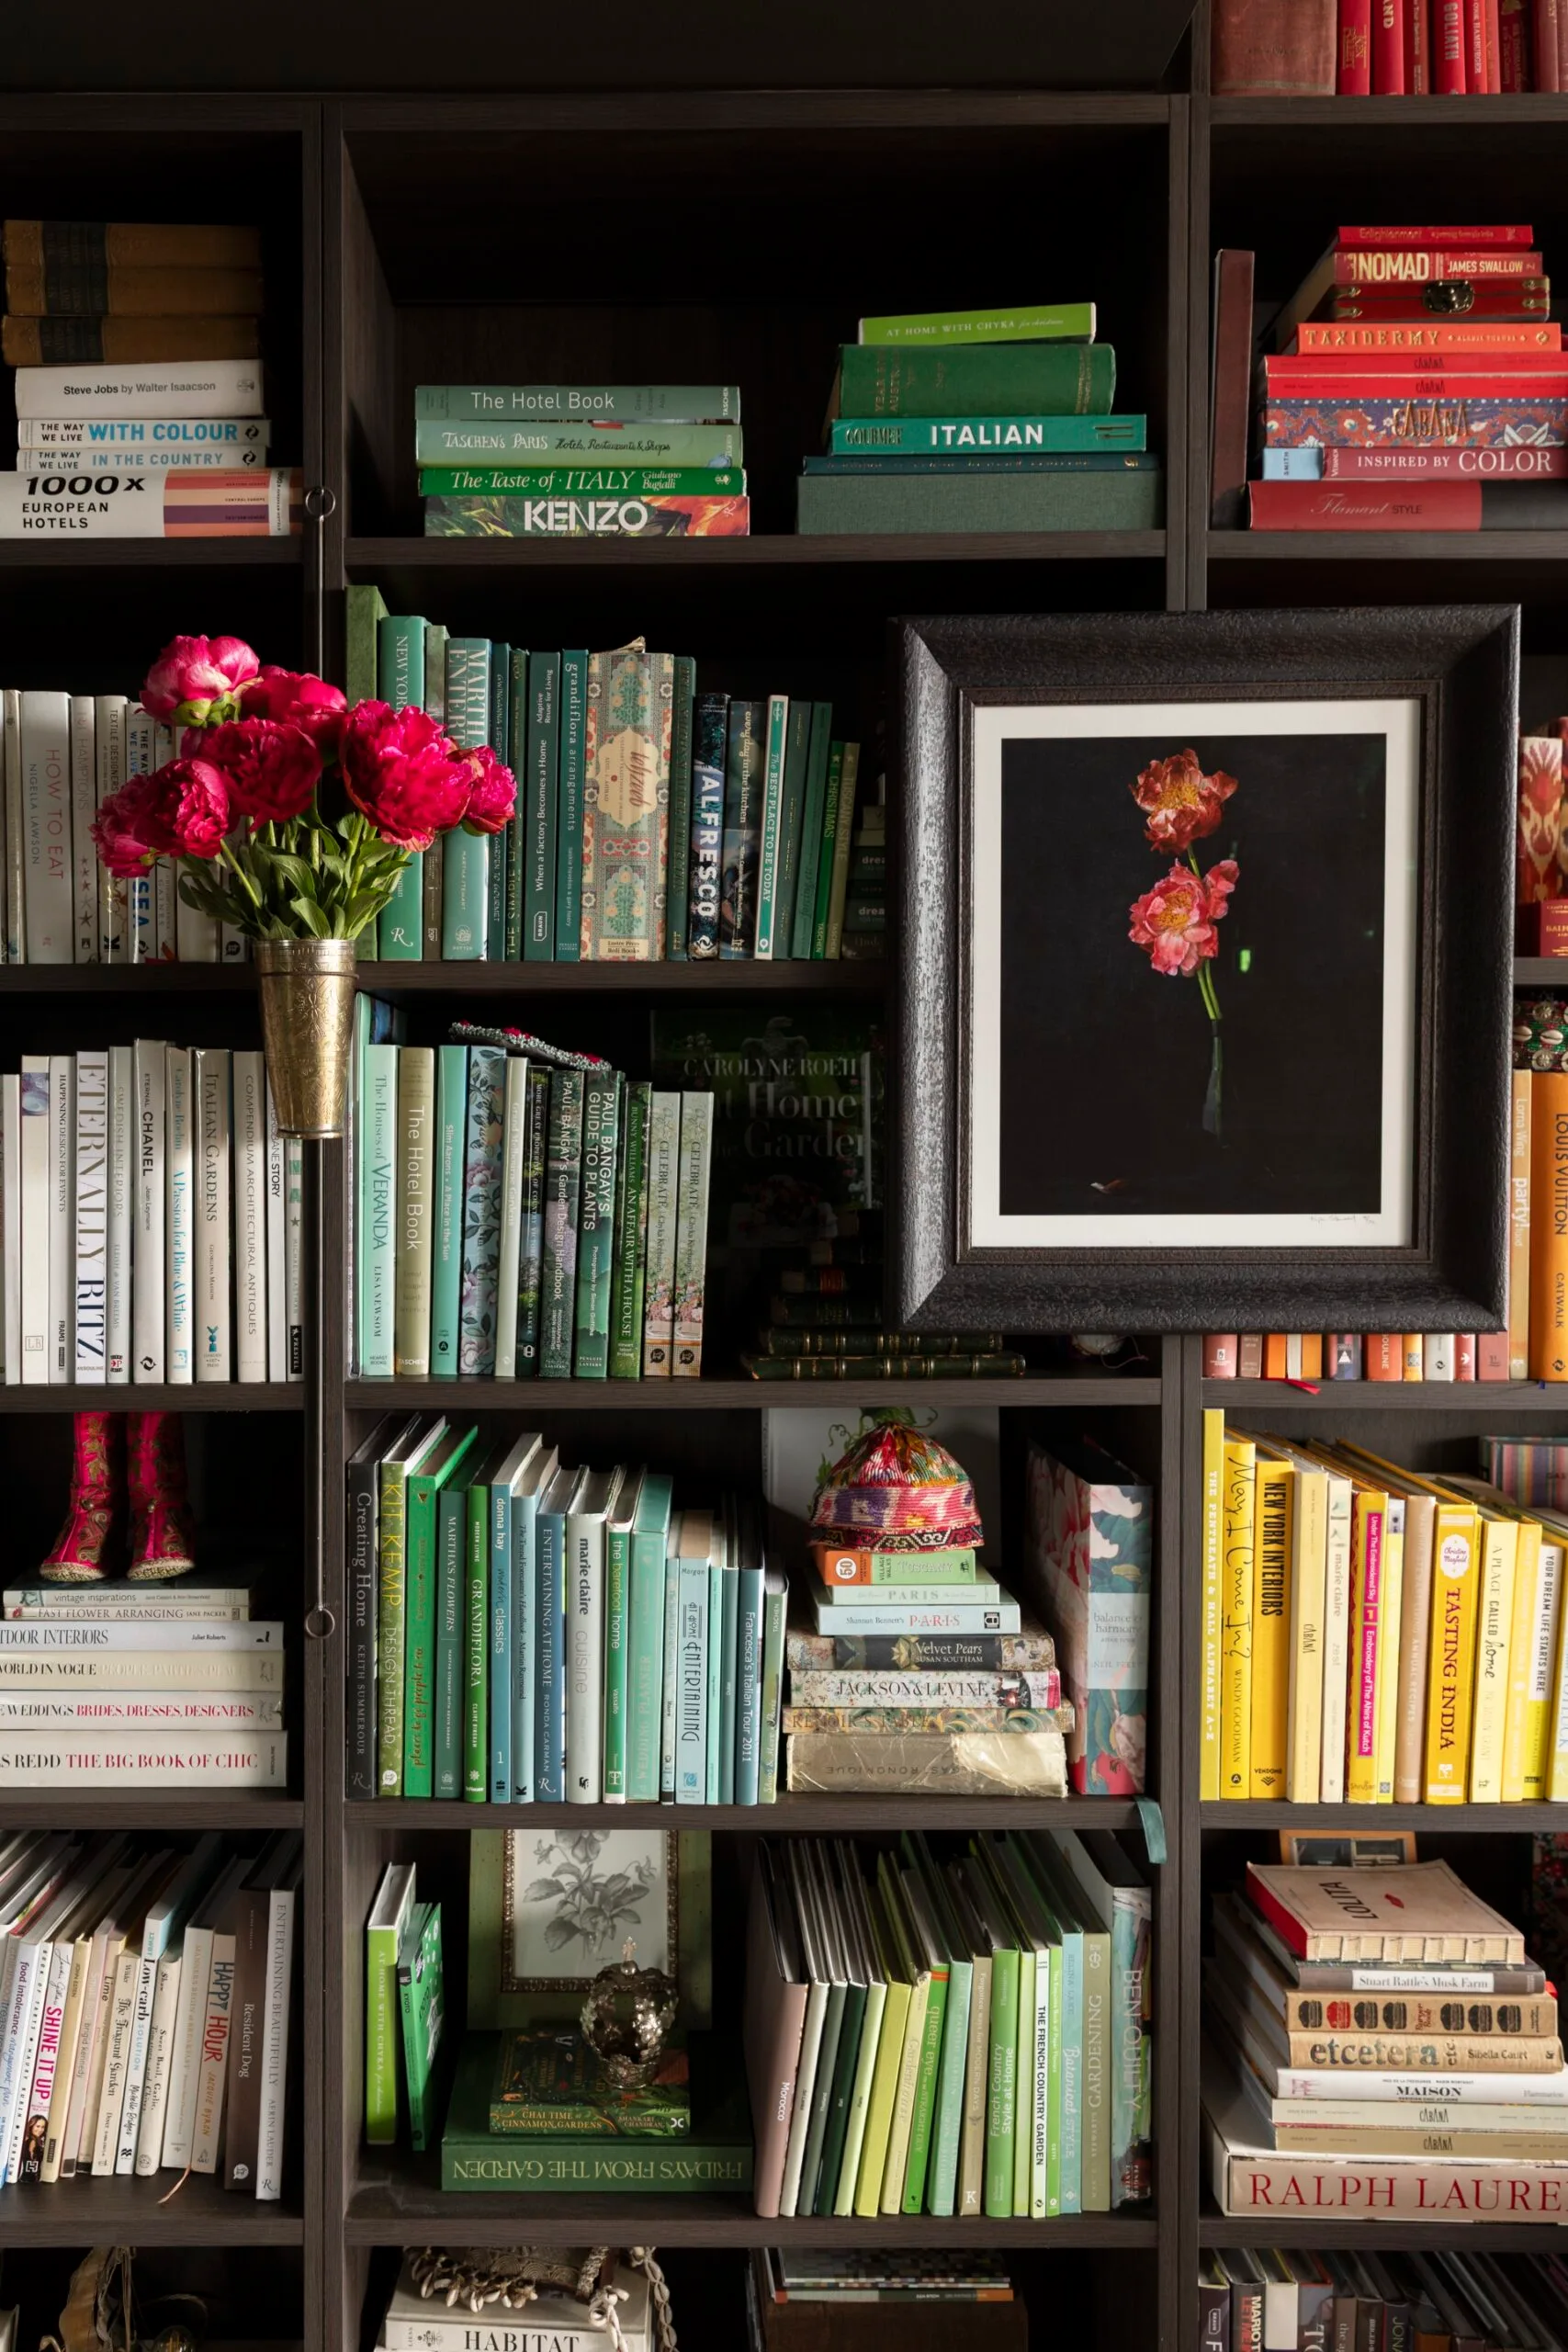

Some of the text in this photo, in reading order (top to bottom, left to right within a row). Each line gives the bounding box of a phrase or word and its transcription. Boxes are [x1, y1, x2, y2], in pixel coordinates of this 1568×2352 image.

[1444, 3, 1459, 60] GOLIATH
[1359, 253, 1429, 280] NOMAD
[1448, 261, 1523, 273] JAMES SWALLOW
[1305, 330, 1439, 345] TAXIDERMY
[63, 382, 216, 395] Steve Jobs by Walter Isaacson
[471, 392, 615, 409] The Hotel Book
[41, 434, 83, 442] WE LIVE
[88, 424, 238, 441] WITH COLOUR
[512, 434, 547, 449] PARIS
[931, 424, 1043, 445] ITALIAN
[452, 470, 636, 492] The Taste of ITALY
[1358, 452, 1552, 472] INSPIRED BY COLOR
[27, 477, 119, 495] 1000
[1311, 494, 1422, 515] Flamant STYLE
[22, 503, 109, 513] EUROPEAN
[23, 518, 89, 528] HOTELS
[524, 501, 648, 531] KENZO
[566, 663, 578, 831] grandiflora arrangements
[29, 763, 40, 865] NIGELLA LAWSON
[46, 750, 63, 879] HOW TO EAT
[537, 777, 547, 819] Becomes
[824, 776, 838, 838] CHRISTMAS
[536, 821, 547, 854] Factory
[698, 776, 719, 917] ALFRESCO
[536, 865, 545, 891] When
[132, 881, 150, 928] SEA
[142, 1112, 153, 1176] CHANEL
[206, 1073, 220, 1222] ITALIAN GARDENS
[584, 1092, 601, 1230] GUIDE TO PLANTS
[599, 1092, 615, 1212] PAUL BANGAY'S
[407, 1106, 424, 1250] The Hotel Book
[659, 1140, 670, 1211] CELEBRATE
[690, 1141, 700, 1212] CELEBRATE
[77, 1064, 106, 1358] ETERNALLY RITZ
[245, 1075, 256, 1335] COMPENDIUM ARCHITECTURAL ANTIQUES
[1554, 1114, 1568, 1328] LOUIS VUITTON CATWALK
[353, 1492, 372, 1567] Creating
[1261, 1483, 1287, 1616] NEW YORK INTERIORS
[1224, 1456, 1255, 1658] May I Come In?
[39, 1609, 62, 1618] FAST
[66, 1609, 110, 1618] FLOWER
[116, 1609, 184, 1618] ARRANGING
[54, 1593, 136, 1603] vintage inspirations
[355, 1573, 371, 1627] Home
[382, 1484, 403, 1744] KIT KEMP DESIGN THREAD
[888, 1589, 939, 1600] PARIS
[916, 1643, 983, 1655] Velvet Pears
[1439, 1589, 1461, 1750] TASTING INDIA
[682, 1642, 702, 1741] ENTERTAINING
[741, 1611, 756, 1762] Francesca's Italian Tour 2011
[7, 1705, 254, 1718] WEDDINGS BRIDES, DRESSES, DESIGNERS
[356, 1684, 365, 1755] SUMMEROUR
[15, 1754, 258, 1768] REDD THE BIG BOOK OF CHIC
[1320, 1881, 1379, 1919] LOLITA
[101, 1976, 112, 2002] Lime
[1359, 1976, 1488, 1988] Stuart Rattle's Musk Farm
[204, 1962, 235, 2063] HAPPY HOUR
[265, 1905, 287, 2167] ENTERTAINING BEAUTIFULLY AERIN LAUDER
[1037, 2028, 1045, 2069] FRENCH
[1089, 1995, 1102, 2107] GARDENING
[1122, 1970, 1143, 2110] BEN QUILTY
[1310, 2038, 1439, 2065] etcetera
[1468, 2048, 1528, 2060] Sibella Court
[778, 2081, 790, 2120] Morocco
[1036, 2072, 1044, 2121] COUNTRY
[1396, 2086, 1461, 2097] MAISON
[1036, 2124, 1044, 2165] GARDEN
[454, 2161, 742, 2178] FRIDAYS FROM THE GARDEN
[1249, 2174, 1396, 2206] RALPH
[1251, 2297, 1262, 2342] MARIO
[464, 2331, 580, 2352] HABITAT
